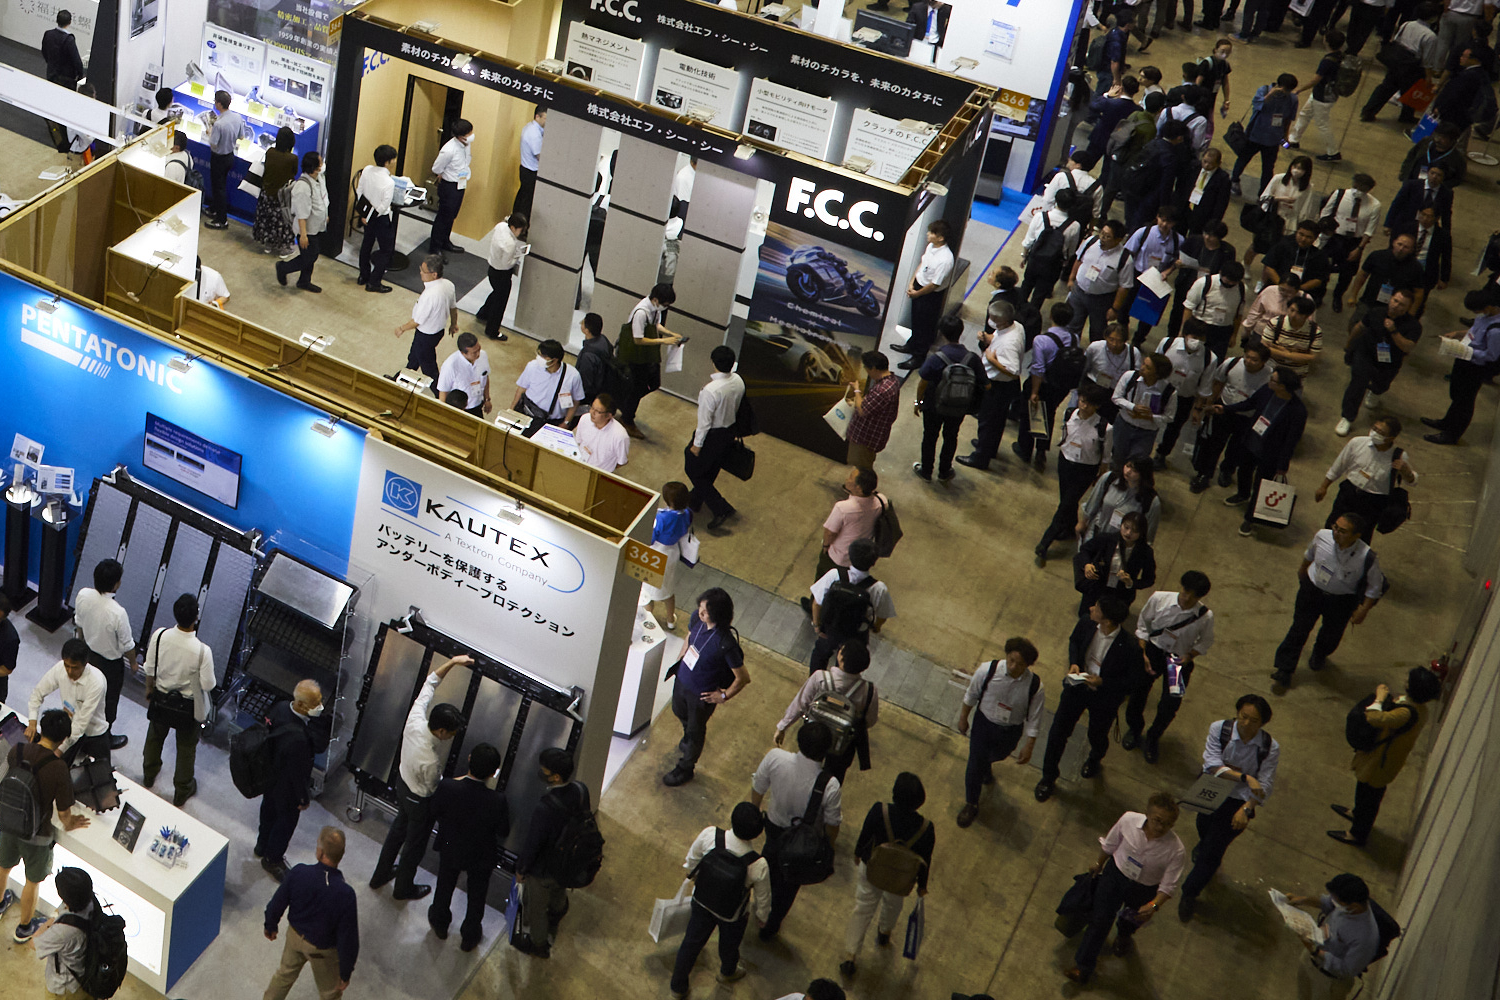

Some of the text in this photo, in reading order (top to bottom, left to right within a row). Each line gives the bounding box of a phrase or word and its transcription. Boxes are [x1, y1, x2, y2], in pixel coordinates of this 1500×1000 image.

[295, 3, 330, 21] 当社設備で
[656, 12, 770, 55] 株式会社エフ・シー・シー
[581, 31, 631, 54] 熱マネジメント
[401, 41, 554, 101] 素材のチカを、未来のカタチに
[679, 62, 717, 81] 電動化技術
[790, 54, 944, 107] 素材のチカラを、未来のカタチに
[757, 88, 829, 114] 小型モビリティ向けモータ
[1001, 91, 1026, 107] 366
[586, 102, 723, 156] 株式会社エフ・シー・シー
[786, 176, 886, 242] F.C.C.
[22, 302, 184, 395] PENTATONIC
[154, 420, 172, 431] Multiple
[378, 521, 509, 592] バッテリーを保護する
[426, 498, 551, 569] KAUTEX
[629, 542, 661, 571] 362
[443, 532, 548, 588] A Textron Company
[377, 537, 576, 638] アンダーボディープロテクション
[1201, 787, 1219, 799] HRS
